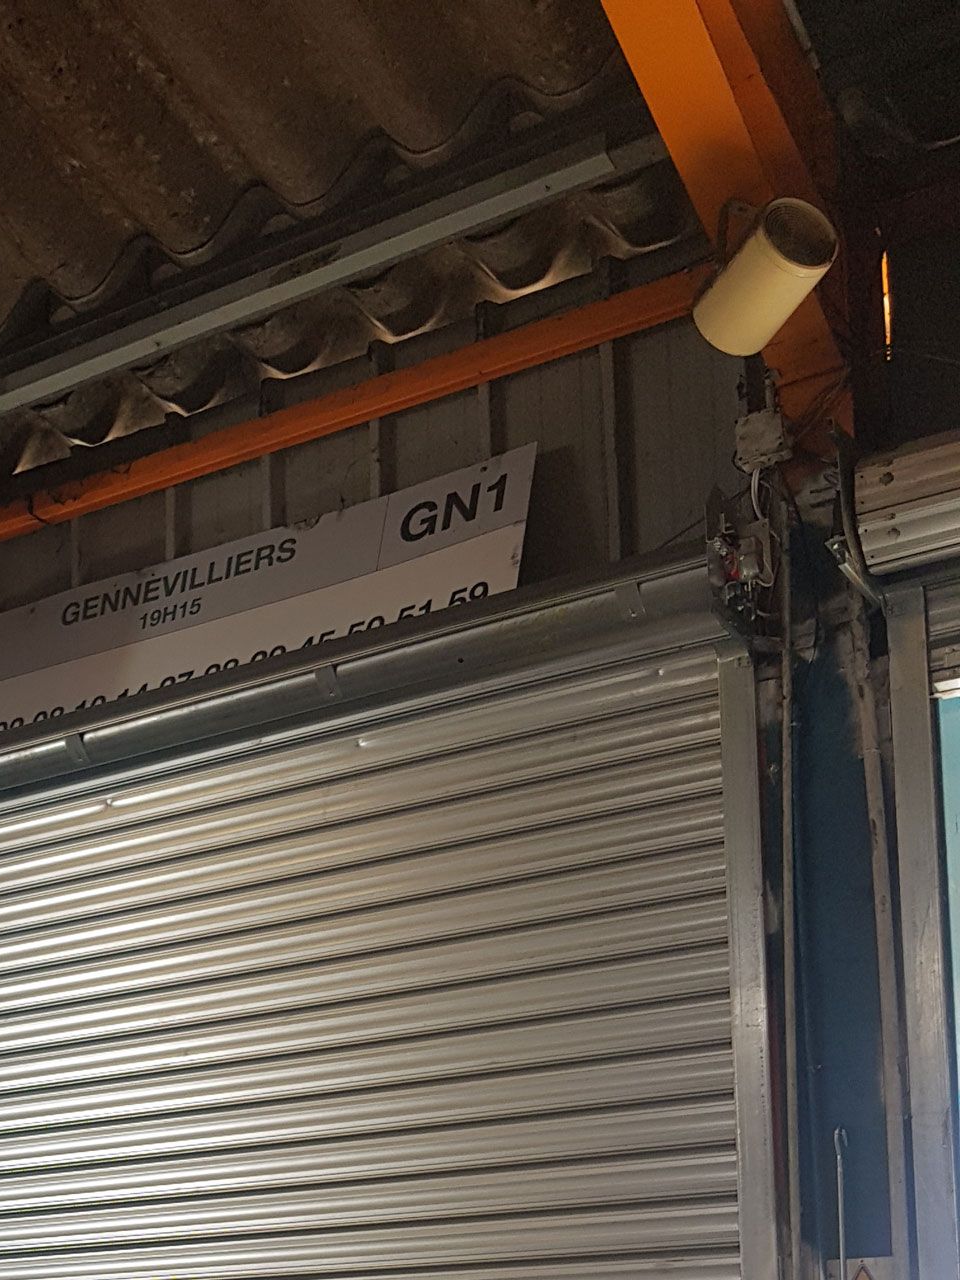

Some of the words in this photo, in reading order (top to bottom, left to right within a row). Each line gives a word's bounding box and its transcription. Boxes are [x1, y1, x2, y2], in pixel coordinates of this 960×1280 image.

[399, 473, 509, 543] GN1
[60, 536, 298, 627] GENNEVILLIERS
[138, 597, 203, 632] 19H15
